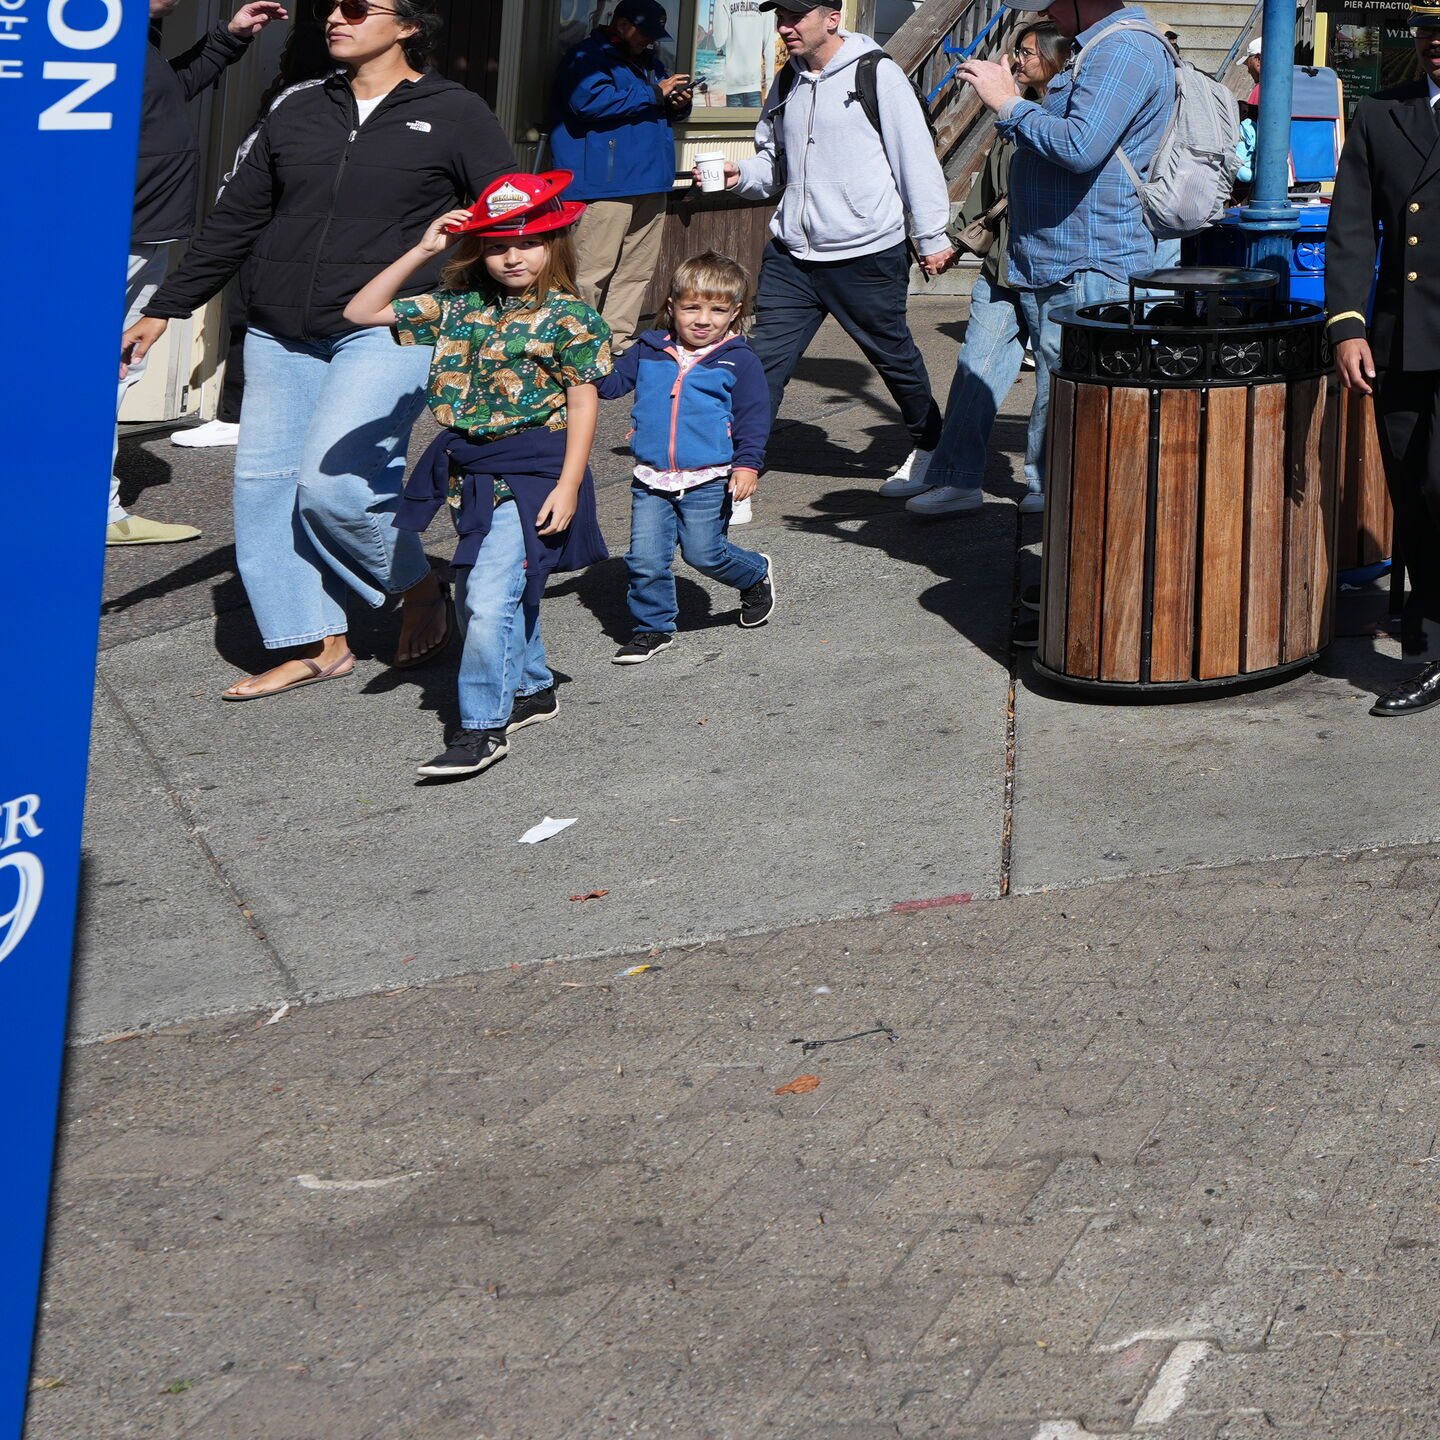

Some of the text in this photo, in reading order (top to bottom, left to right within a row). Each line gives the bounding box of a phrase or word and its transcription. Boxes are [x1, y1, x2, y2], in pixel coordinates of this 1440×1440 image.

[729, 2, 740, 15] SAN
[1344, 0, 1411, 10] PIER ATTRACTIO
[491, 194, 524, 203] OAKLAND
